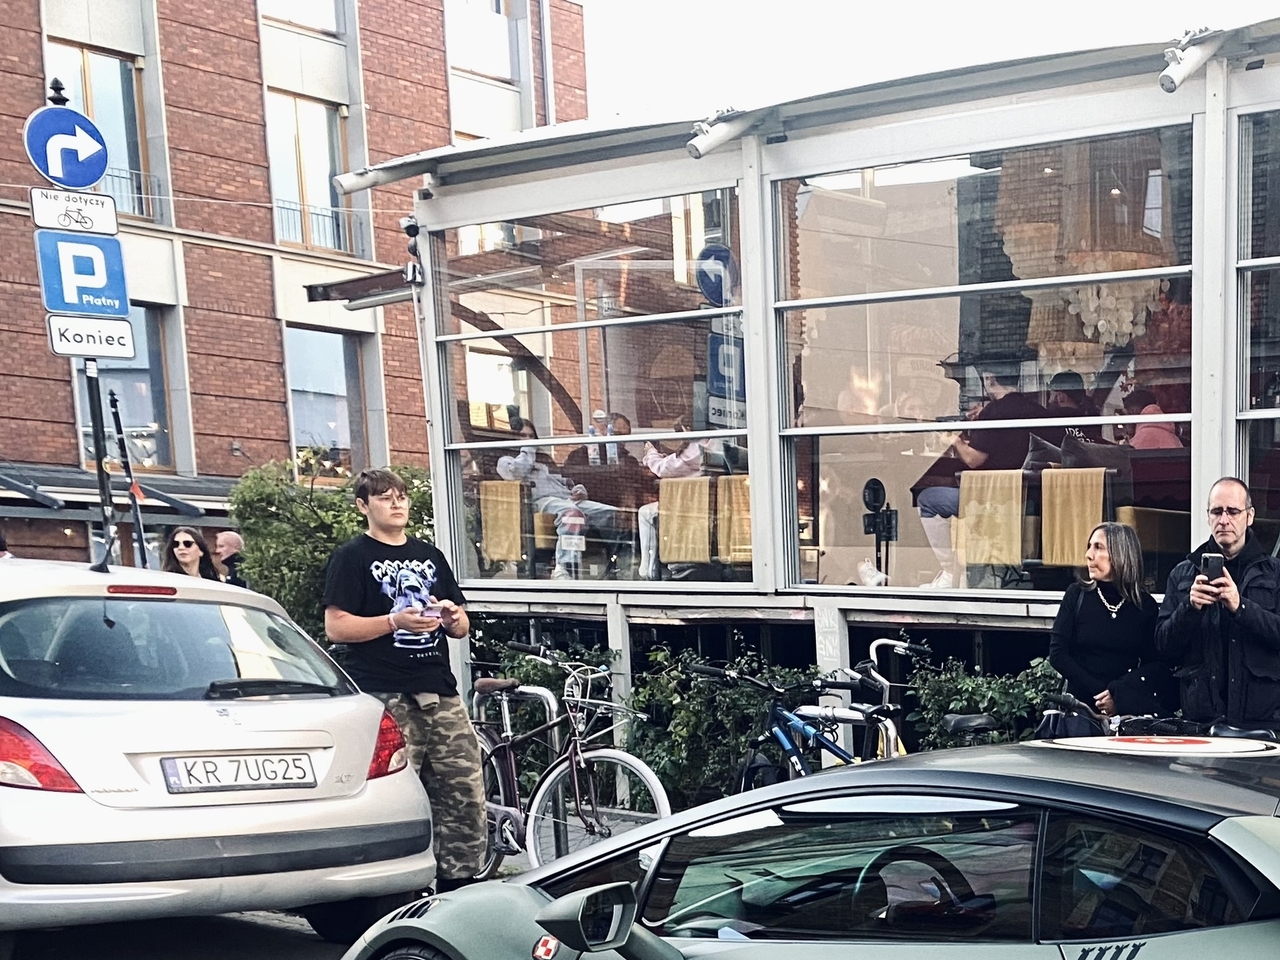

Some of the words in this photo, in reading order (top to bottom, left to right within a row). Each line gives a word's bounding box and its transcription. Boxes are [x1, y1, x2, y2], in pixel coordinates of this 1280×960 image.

[40, 190, 59, 201] Nie
[64, 194, 105, 209] dotyczy
[57, 241, 108, 304] P
[58, 328, 127, 347] Koniec
[184, 760, 221, 785] KR
[228, 758, 307, 782] 7UG25
